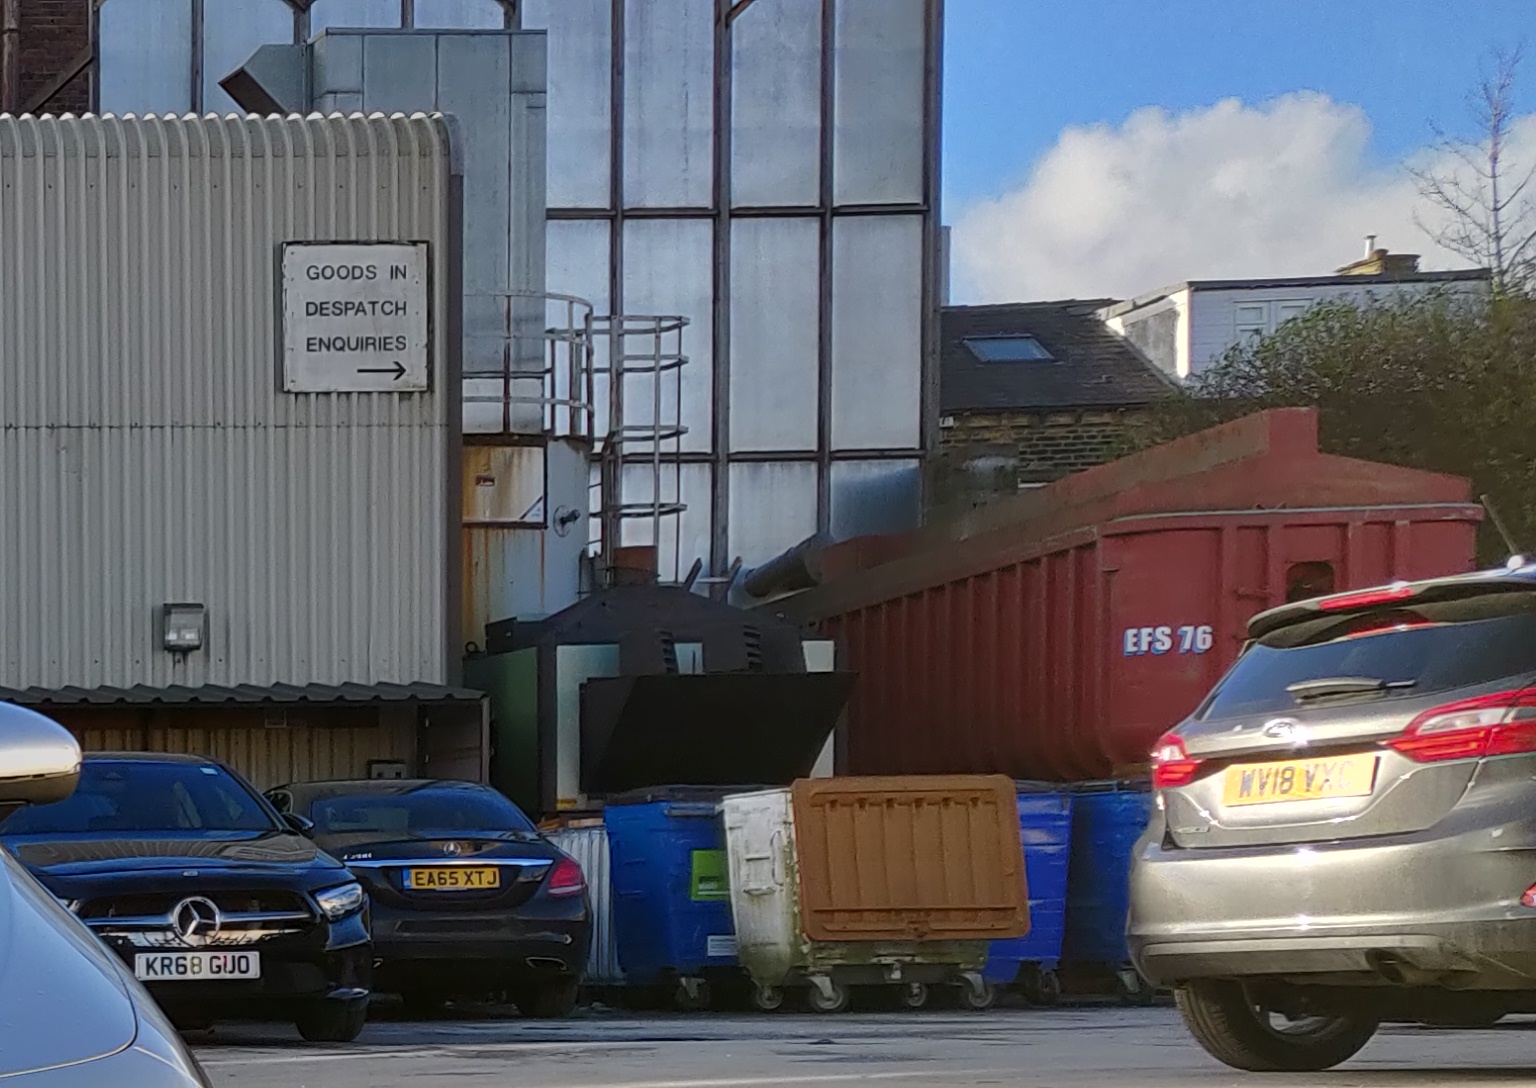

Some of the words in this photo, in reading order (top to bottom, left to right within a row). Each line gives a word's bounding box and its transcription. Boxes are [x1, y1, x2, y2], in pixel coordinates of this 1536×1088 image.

[306, 264, 378, 281] GOODS
[390, 264, 407, 281] IN
[305, 300, 407, 317] DESPATCH
[306, 335, 407, 353] ENQUIRIES
[1123, 625, 1173, 656] EFS
[1177, 624, 1214, 654] 76
[414, 870, 459, 887] EA65
[463, 870, 497, 887] XTJ
[145, 955, 203, 976] KR68
[209, 954, 250, 975] GUO
